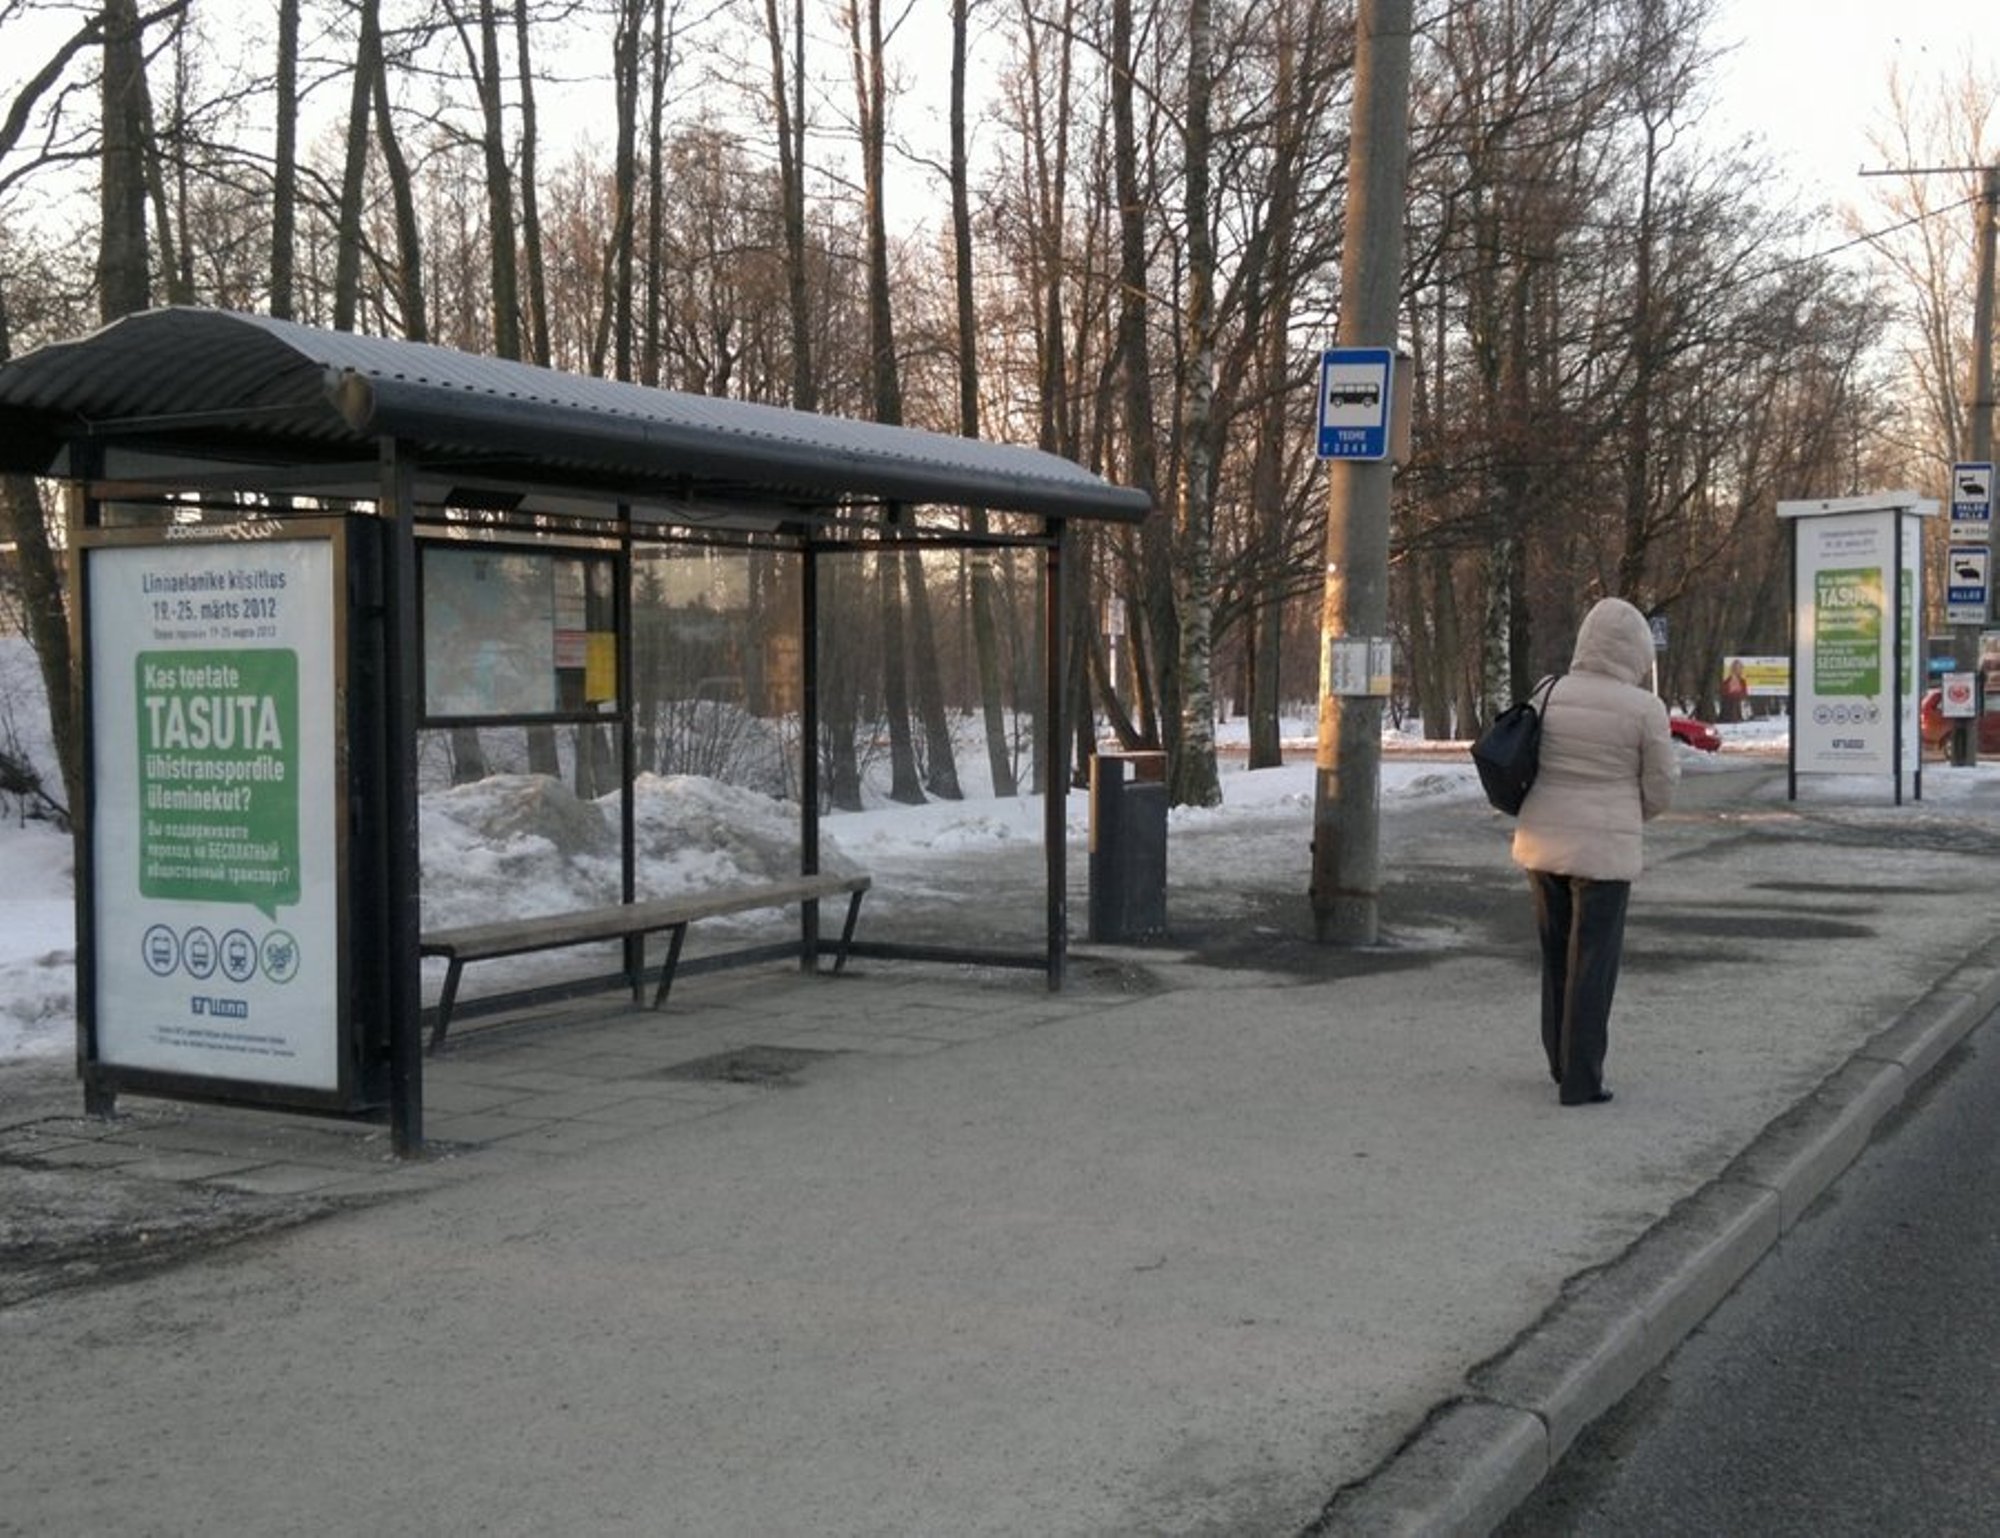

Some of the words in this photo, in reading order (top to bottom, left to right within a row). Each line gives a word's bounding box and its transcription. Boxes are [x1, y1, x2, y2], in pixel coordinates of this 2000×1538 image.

[142, 571, 225, 594] Linnaelanike
[201, 599, 239, 620] märts
[242, 597, 277, 619] 2012
[144, 665, 177, 690] Kas
[180, 664, 240, 689] toetate
[145, 694, 283, 751] TASUTA
[146, 754, 284, 786] ühistranspordile
[147, 783, 252, 812] üleminekut?
